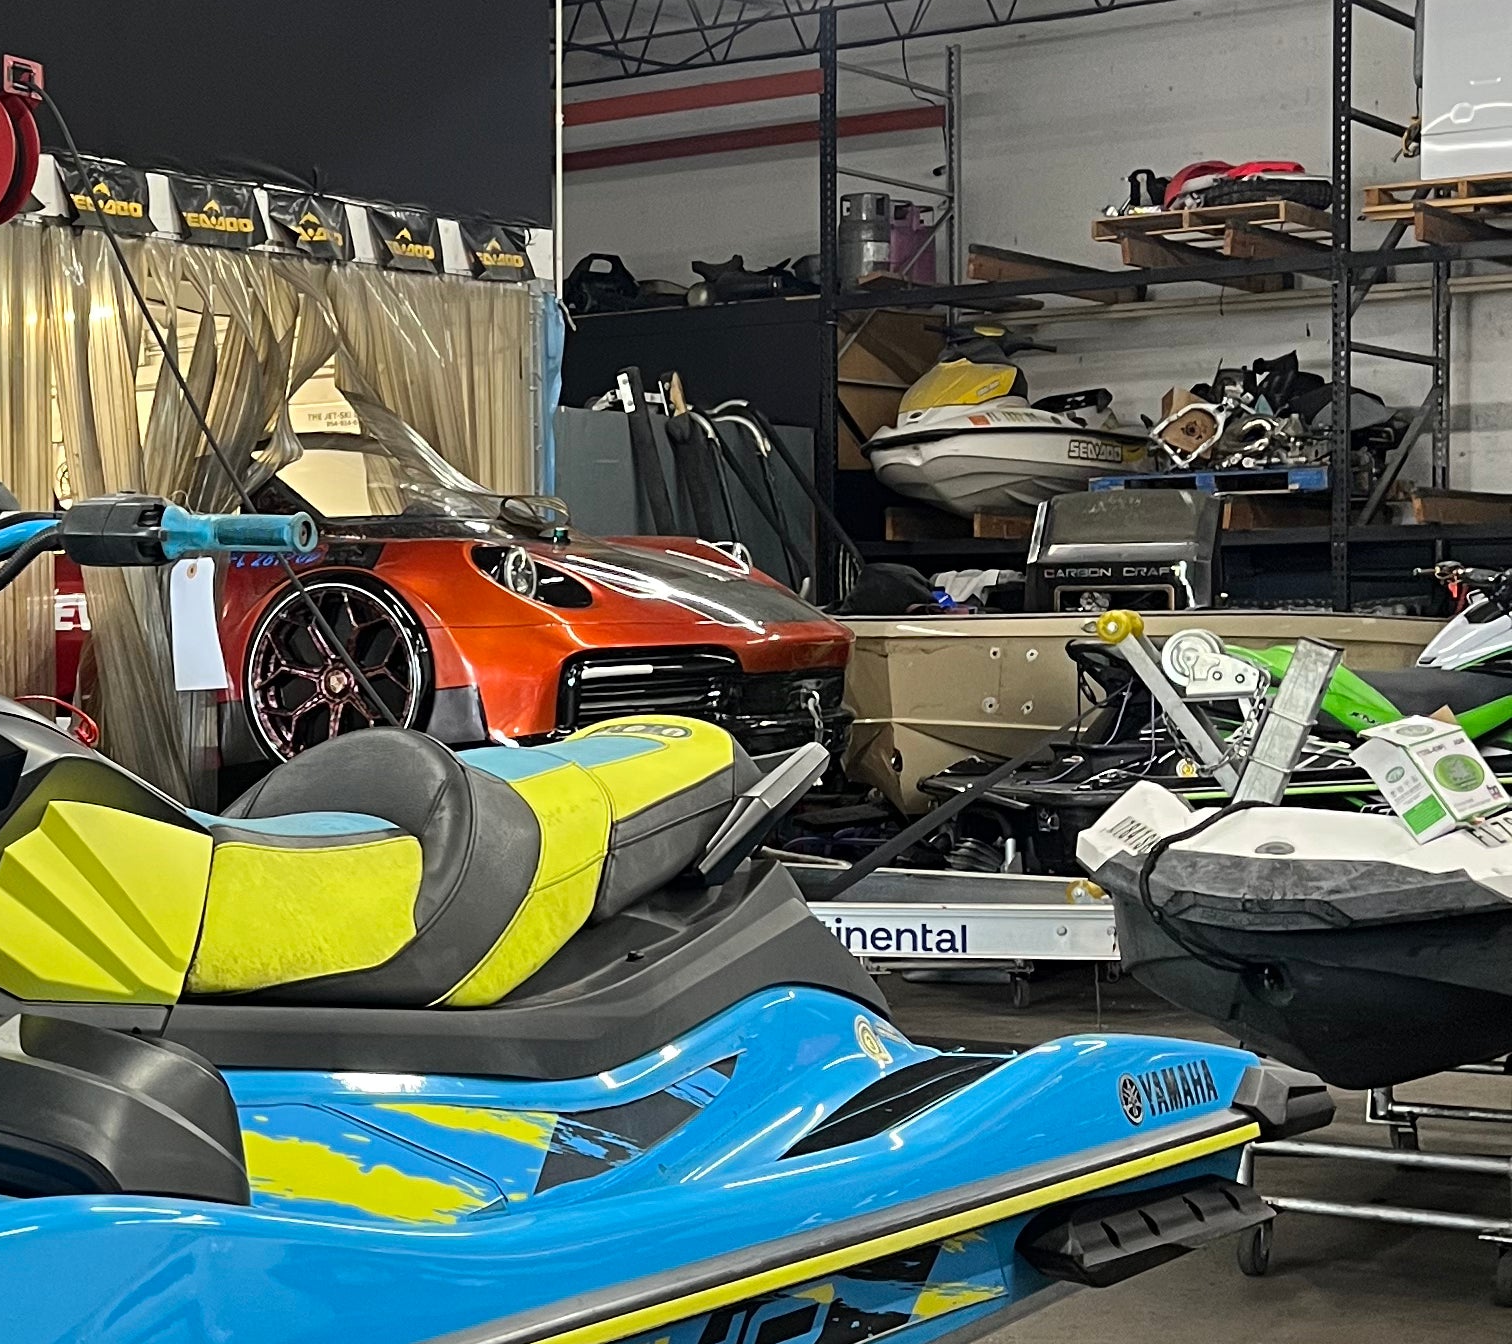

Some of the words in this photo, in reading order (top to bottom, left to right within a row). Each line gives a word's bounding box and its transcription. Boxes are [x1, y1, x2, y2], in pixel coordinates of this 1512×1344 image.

[1044, 567, 1112, 579] CARBON
[823, 917, 968, 954] inental
[1136, 1058, 1219, 1117] YAMAHA
